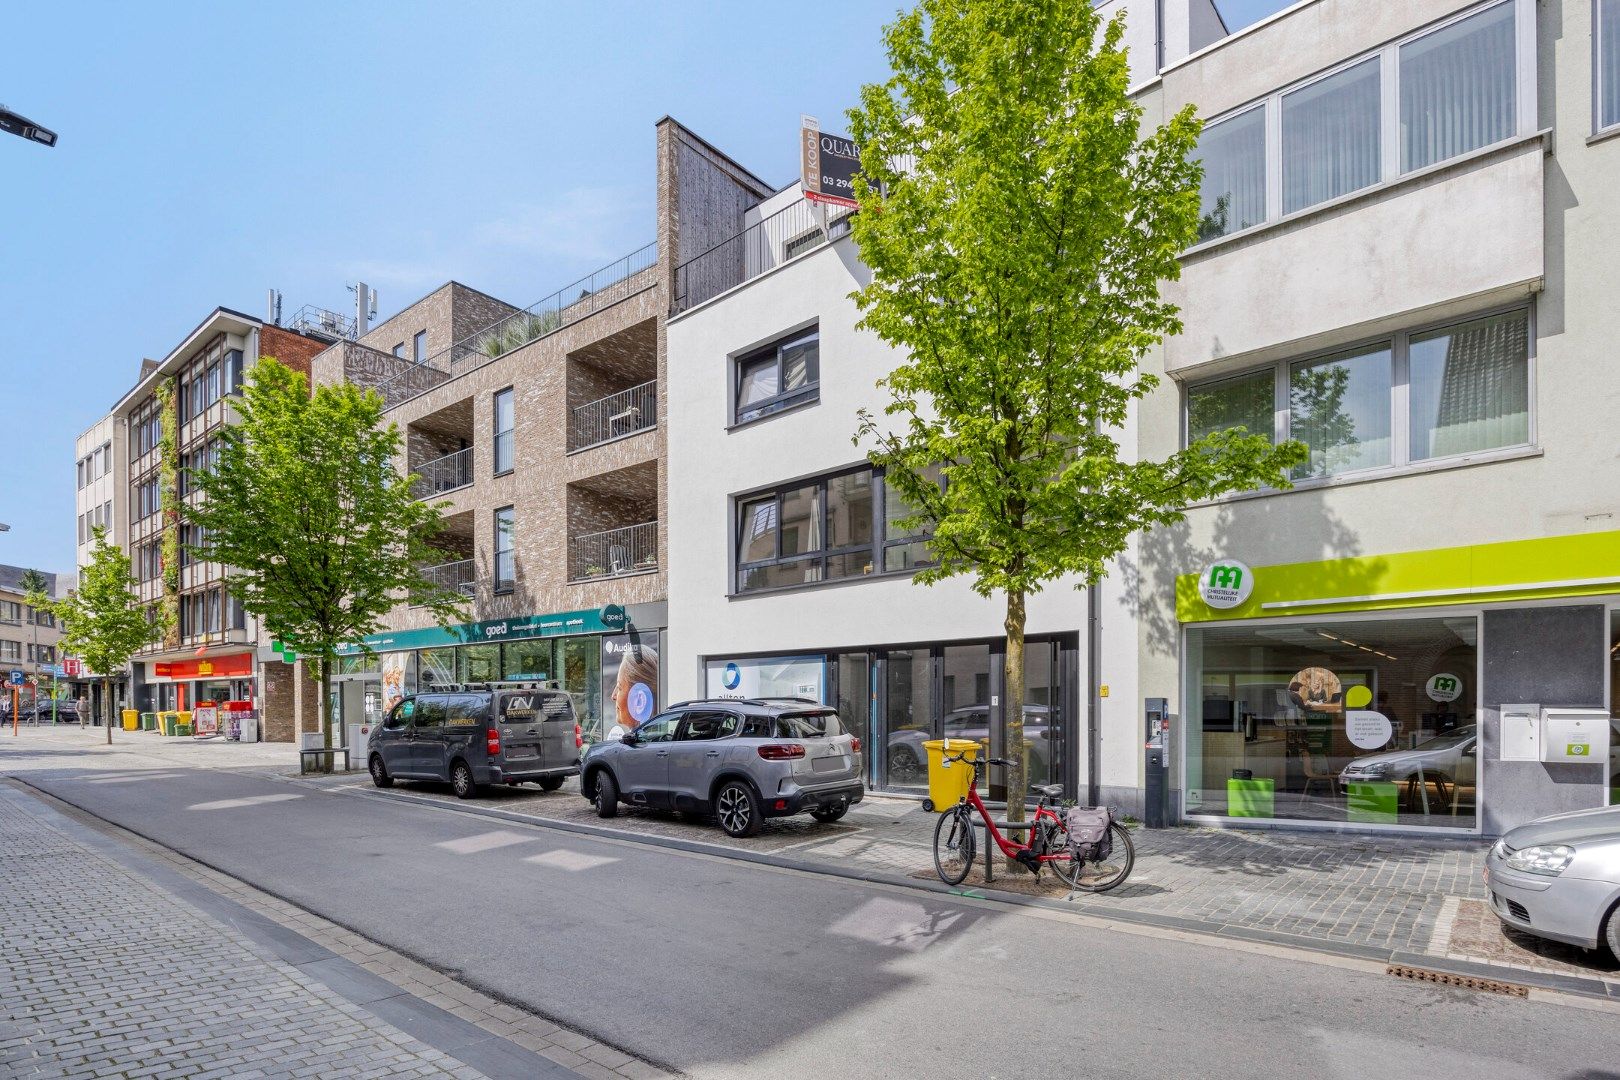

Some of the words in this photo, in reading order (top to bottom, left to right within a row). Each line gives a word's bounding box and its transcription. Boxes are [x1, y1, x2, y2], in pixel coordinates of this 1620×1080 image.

[807, 132, 818, 169] KOOP
[808, 174, 818, 186] TE
[822, 175, 834, 185] 03
[1206, 594, 1238, 602] MUTUALITEIT
[606, 613, 623, 622] goed
[485, 622, 507, 638] goed
[613, 642, 638, 653] Audika
[67, 661, 79, 674] H
[11, 672, 22, 683] P
